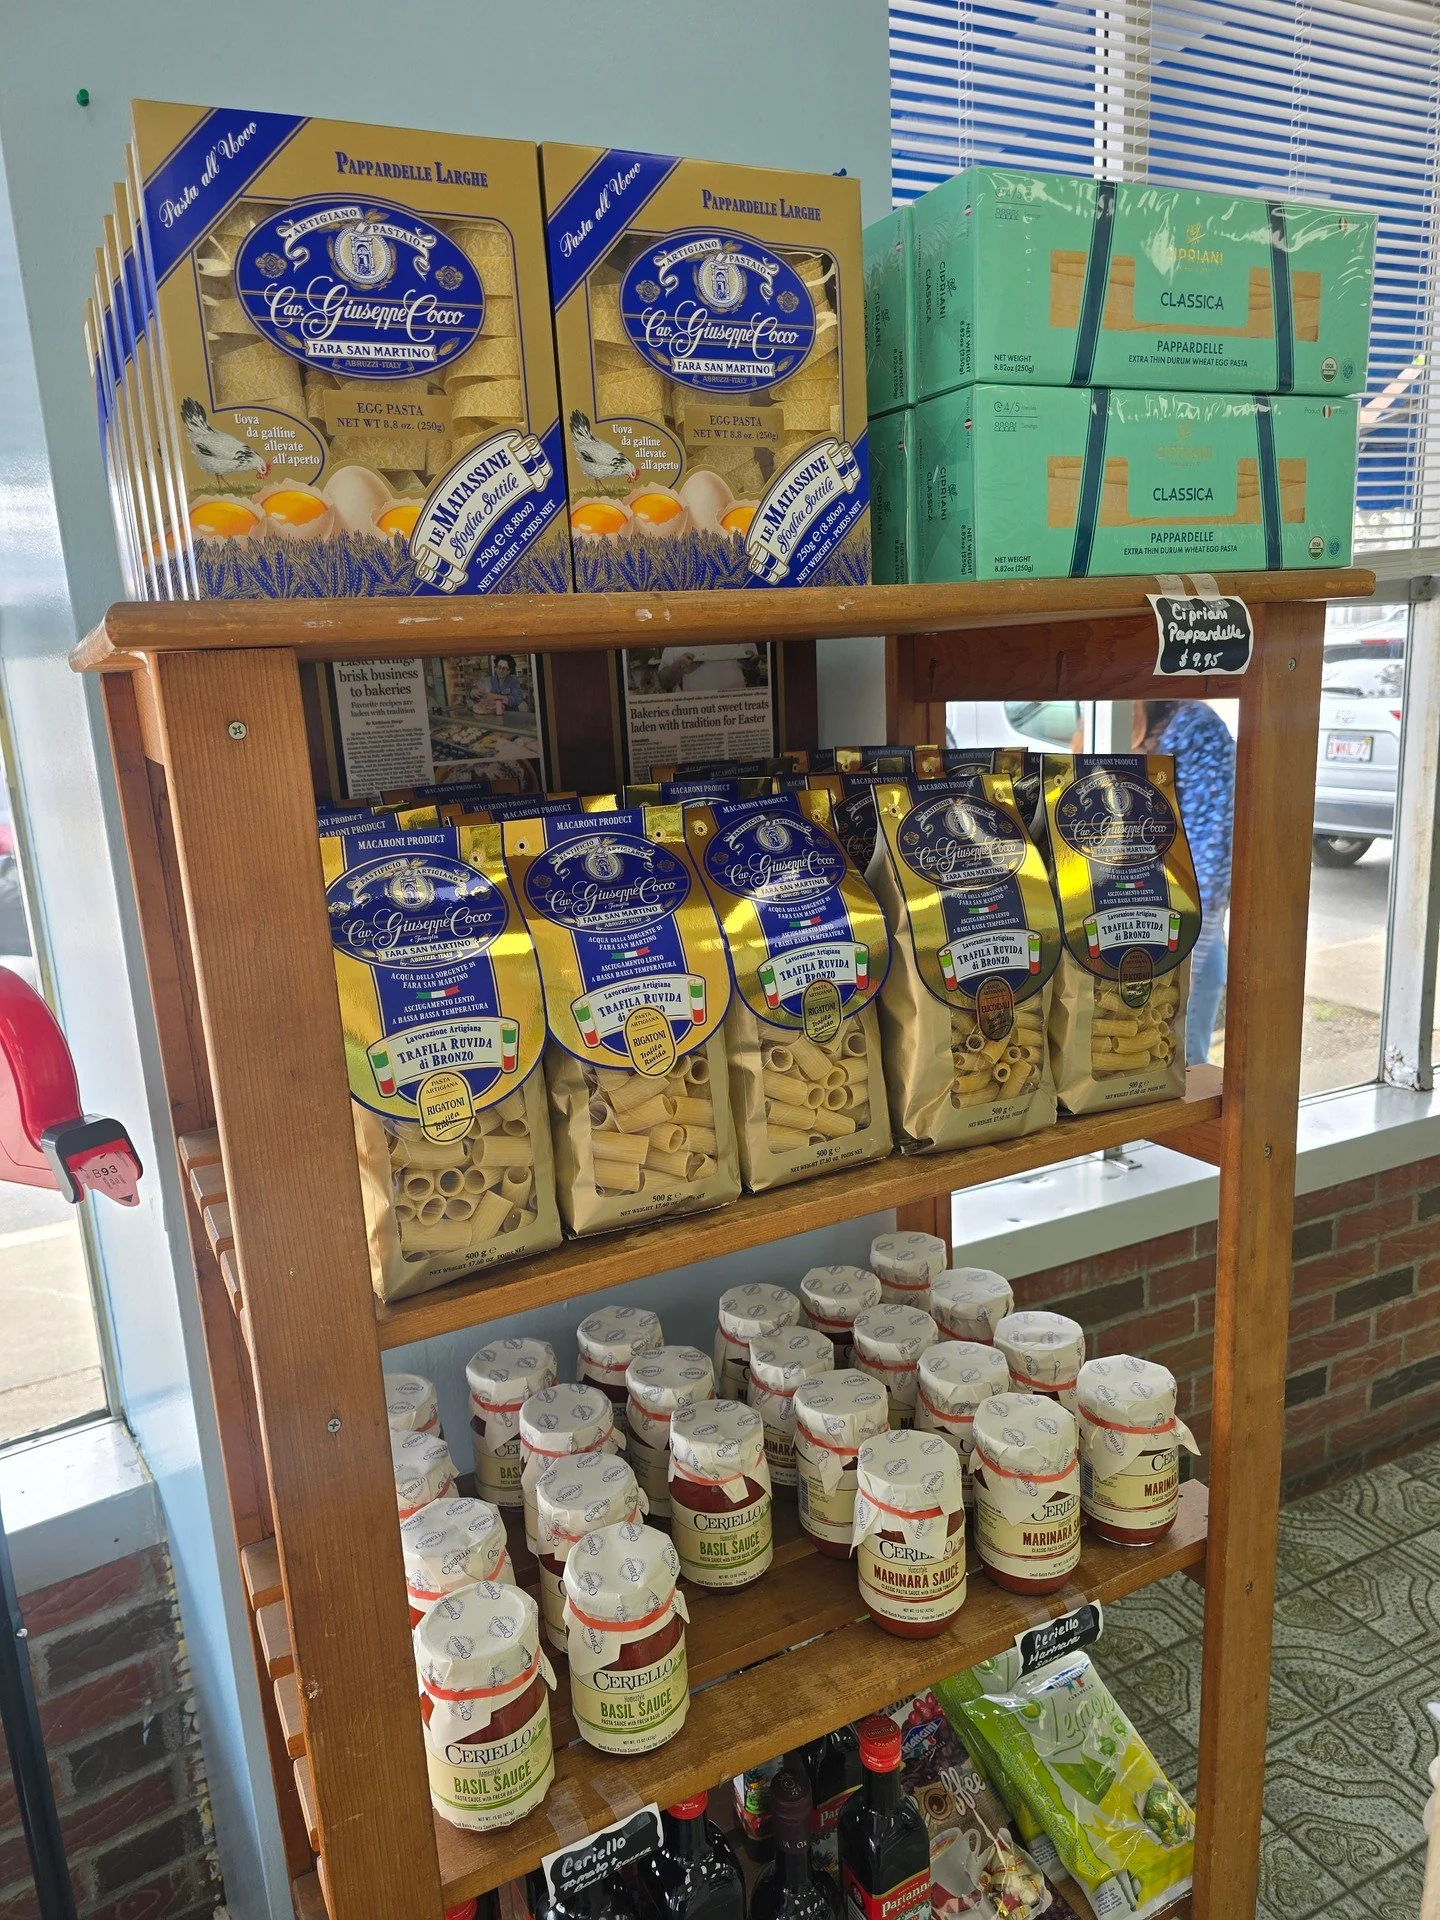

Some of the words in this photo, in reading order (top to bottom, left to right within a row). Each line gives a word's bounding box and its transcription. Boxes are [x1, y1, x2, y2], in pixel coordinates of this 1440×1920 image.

[158, 185, 199, 229] Pasta
[219, 120, 257, 158] Uovo
[334, 150, 434, 183] PAPPARDELLE
[435, 161, 489, 188] LARGHE
[701, 189, 777, 216] PAPPARDELLE
[780, 199, 821, 221] LARGHE
[290, 207, 359, 237] ARTIGIANO
[372, 222, 422, 248] PASTAIO
[264, 282, 305, 327] Cav.
[301, 275, 409, 341] Giuseppe
[403, 288, 465, 342] Cocco
[1160, 292, 1224, 310] CLASSICA
[641, 307, 673, 347] Cav.
[669, 300, 754, 358] Giuseppe
[751, 312, 799, 360] Cocco
[312, 342, 342, 357] FARA
[346, 344, 371, 357] SAN
[374, 345, 431, 359] MARTINO
[1157, 341, 1224, 355] PAPPARDELLE
[993, 363, 1014, 371] 8.82oz
[1015, 364, 1034, 373] (250g)
[1128, 355, 1149, 364] EXTRA
[1150, 356, 1166, 364] THIN
[1167, 357, 1191, 365] DURUM
[1192, 358, 1214, 366] WHEAT
[1215, 358, 1229, 366] EGG
[1230, 359, 1248, 367] PASTA
[234, 413, 260, 424] Uova
[356, 402, 382, 415] EGG
[386, 404, 425, 416] PASTA
[246, 428, 259, 437] da
[261, 427, 296, 440] galline
[337, 416, 364, 428] NET
[366, 417, 381, 429] WT
[401, 420, 414, 431] oz.
[417, 420, 445, 433] (250g)
[264, 440, 304, 451] allevate
[272, 452, 321, 466] all'aperto
[436, 448, 511, 534] MATASSINE
[764, 455, 829, 529] MATASSINE
[1152, 487, 1214, 501] CLASSICA
[453, 512, 486, 559] Sfoglia
[483, 474, 519, 517] Sottile
[428, 522, 446, 547] LE
[477, 543, 500, 568] 250g
[503, 500, 535, 538] (8.80oz)
[761, 525, 775, 543] LE
[1150, 532, 1214, 543] PAPPARDELLE
[1172, 604, 1228, 625] Cipriani
[1167, 622, 1246, 644] Pappardelle
[339, 670, 370, 682] brisk
[371, 669, 418, 681] business
[350, 687, 363, 697] to
[364, 684, 411, 696] bakeries
[350, 709, 369, 717] laden
[379, 700, 401, 709] recipes
[631, 706, 670, 719] Bakeries
[672, 704, 698, 716] churn
[701, 704, 715, 714] out
[718, 703, 743, 712] sweet
[745, 700, 769, 710] treats
[631, 721, 656, 733] laden
[659, 718, 680, 731] with
[682, 717, 721, 728] tradition
[723, 716, 736, 726] for
[739, 714, 766, 724] Easter
[723, 802, 759, 814] MACARONI
[760, 796, 789, 806] PRODUCT
[557, 821, 598, 830] MACARONI
[599, 816, 632, 826] PRODUCT
[358, 838, 405, 850] MACARONI
[407, 835, 445, 845] PRODUCT
[360, 861, 401, 884] PASTIFICIO
[416, 869, 458, 882] ARTIGIANO
[572, 880, 641, 917] Giuseppe
[634, 876, 676, 903] Cocco
[341, 920, 373, 946] Cav.
[372, 909, 452, 950] Giuseppe
[445, 907, 493, 937] Cocco
[1102, 922, 1134, 934] TRAFILA
[1136, 920, 1163, 932] RUVIDA
[1115, 933, 1122, 941] di
[1123, 931, 1150, 940] BRONZO
[385, 949, 408, 958] FARA
[410, 946, 427, 954] SAN
[429, 940, 471, 952] MARTINO
[957, 949, 991, 965] TRAFILA
[993, 945, 1023, 955] RUVIDA
[779, 964, 816, 982] TRAFILA
[819, 958, 849, 970] RUVIDA
[454, 995, 475, 1004] LENTO
[598, 999, 641, 1018] TRAFILA
[644, 992, 682, 1008] RUVIDA
[397, 1014, 418, 1023] BASSA
[419, 1011, 440, 1020] BASSA
[441, 1003, 488, 1017] TEMPERATURA
[405, 1027, 448, 1045] Lavorazione
[450, 1025, 482, 1033] Artigiana
[633, 1030, 666, 1046] RIGATONI
[397, 1042, 446, 1065] TRAFILA
[451, 1037, 493, 1049] RUVIDA
[640, 1043, 663, 1058] Trafila
[645, 1050, 667, 1066] Ruvida
[419, 1058, 429, 1070] di
[432, 1051, 474, 1067] BRONZO
[427, 1097, 465, 1116] RIGATONI
[465, 1250, 479, 1261] 500
[694, 1505, 761, 1531] CERIELLO
[700, 1540, 728, 1555] BASIL
[732, 1531, 760, 1554] SAUCE
[1023, 1527, 1072, 1546] MARINARA
[874, 1564, 929, 1588] MARINARA
[933, 1562, 959, 1587] SAUCE
[1035, 1618, 1079, 1649] Ceriello
[593, 1660, 673, 1691] CERIELLO
[601, 1702, 634, 1718] BASIL
[639, 1688, 672, 1716] SAUCE
[445, 1729, 531, 1765] CERIELLO
[454, 1775, 490, 1793] BASIL
[494, 1760, 531, 1788] SAUCE
[562, 1837, 626, 1878] Ceriello
